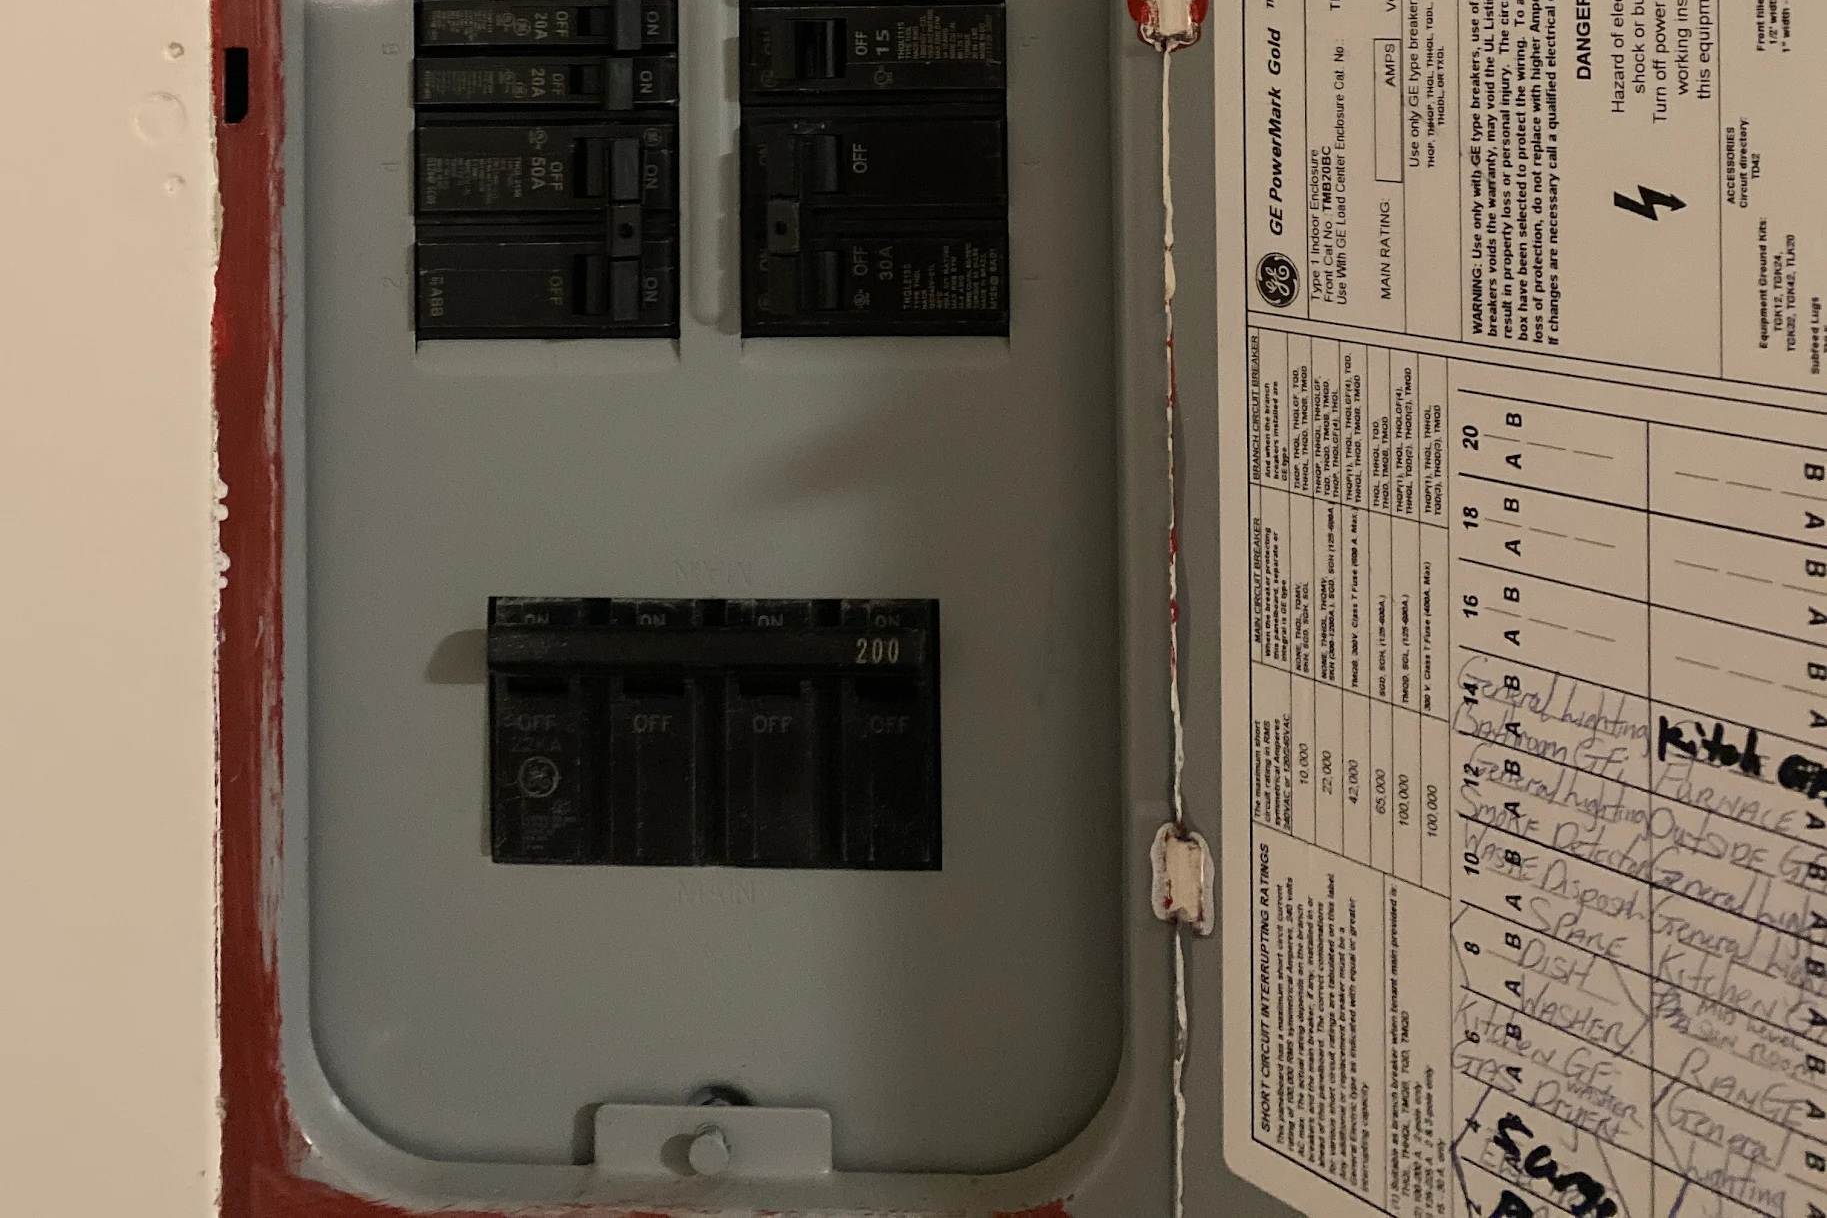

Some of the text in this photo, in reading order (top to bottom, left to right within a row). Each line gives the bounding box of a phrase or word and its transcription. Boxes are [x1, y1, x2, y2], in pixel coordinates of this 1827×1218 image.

[1468, 0, 1479, 15] of
[535, 13, 548, 39] 20A
[555, 11, 568, 38] OFF
[1470, 18, 1480, 43] use
[1633, 21, 1645, 39] or
[1654, 1, 1670, 54] power
[856, 30, 868, 56] OFF
[875, 29, 889, 53] 15
[1266, 27, 1281, 76] Gold
[1482, 34, 1495, 53] UL
[1609, 32, 1625, 49] of
[1383, 43, 1396, 88] AMPS
[1407, 53, 1421, 82] type
[1483, 56, 1495, 79] the
[1630, 43, 1646, 95] shock
[1651, 59, 1667, 81] off
[1673, 28, 1693, 96] working
[531, 68, 545, 97] 20A
[551, 73, 564, 98] OFF
[1468, 47, 1482, 110] breakers,
[1609, 54, 1625, 114] Hazard
[1695, 68, 1711, 100] this
[1407, 86, 1419, 108] GE
[1483, 81, 1495, 111] void
[1651, 86, 1668, 125] Turn
[1333, 94, 1345, 151] Enclosure
[1407, 110, 1423, 139] only
[1469, 113, 1484, 143] type
[1486, 114, 1498, 143] may
[853, 143, 867, 173] OFF
[1267, 86, 1283, 204] PowerMark
[1408, 141, 1420, 168] Use
[1467, 145, 1481, 169] GE
[532, 157, 546, 188] 50A
[549, 161, 563, 191] OFF
[1334, 154, 1346, 193] Center
[1484, 146, 1499, 209] warranty,
[1725, 127, 1736, 205] ACCESSORIES
[1738, 116, 1750, 209] Circuit directory:
[1749, 153, 1761, 180] TD42
[1308, 149, 1320, 211] Enclosure
[1320, 146, 1332, 213] TMB20BC
[1470, 169, 1483, 199] with
[1268, 205, 1283, 237] GE
[1334, 196, 1346, 226] Load
[1470, 200, 1484, 230] only
[1485, 212, 1497, 235] the
[1309, 214, 1320, 255] Indoor
[1335, 229, 1347, 249] GE
[1471, 233, 1482, 260] Use
[852, 246, 868, 274] OFF
[1322, 244, 1333, 267] Cat
[1335, 252, 1347, 279] With
[1485, 238, 1497, 275] voids
[644, 276, 659, 302] ON
[1309, 270, 1323, 302] Type
[1322, 270, 1334, 303] Front
[1335, 282, 1347, 306] Use
[1379, 262, 1391, 301] MAIN
[1757, 216, 1770, 350] Equipment Ground Kits:
[1471, 263, 1483, 335] WARNING:
[1485, 278, 1498, 338] breakers
[1251, 335, 1261, 481] BRANCH CIRCUIT BREAKER
[1462, 425, 1479, 452] 20
[1462, 505, 1479, 531] 18
[1252, 517, 1262, 644] MAIN CIRCUIT BREAKER
[1462, 594, 1479, 619] 16
[856, 637, 899, 664] 200
[633, 715, 672, 733] OFF
[753, 715, 792, 733] OFF
[1347, 761, 1359, 806] 42,000
[1463, 762, 1480, 788] 12
[1374, 768, 1387, 816] 65,000
[1396, 774, 1410, 827] 100,000
[1464, 851, 1480, 876] 10
[1464, 940, 1480, 956] 8
[1259, 842, 1271, 1134] SHORT CIRCUIT INTERRUPTING RATINGS
